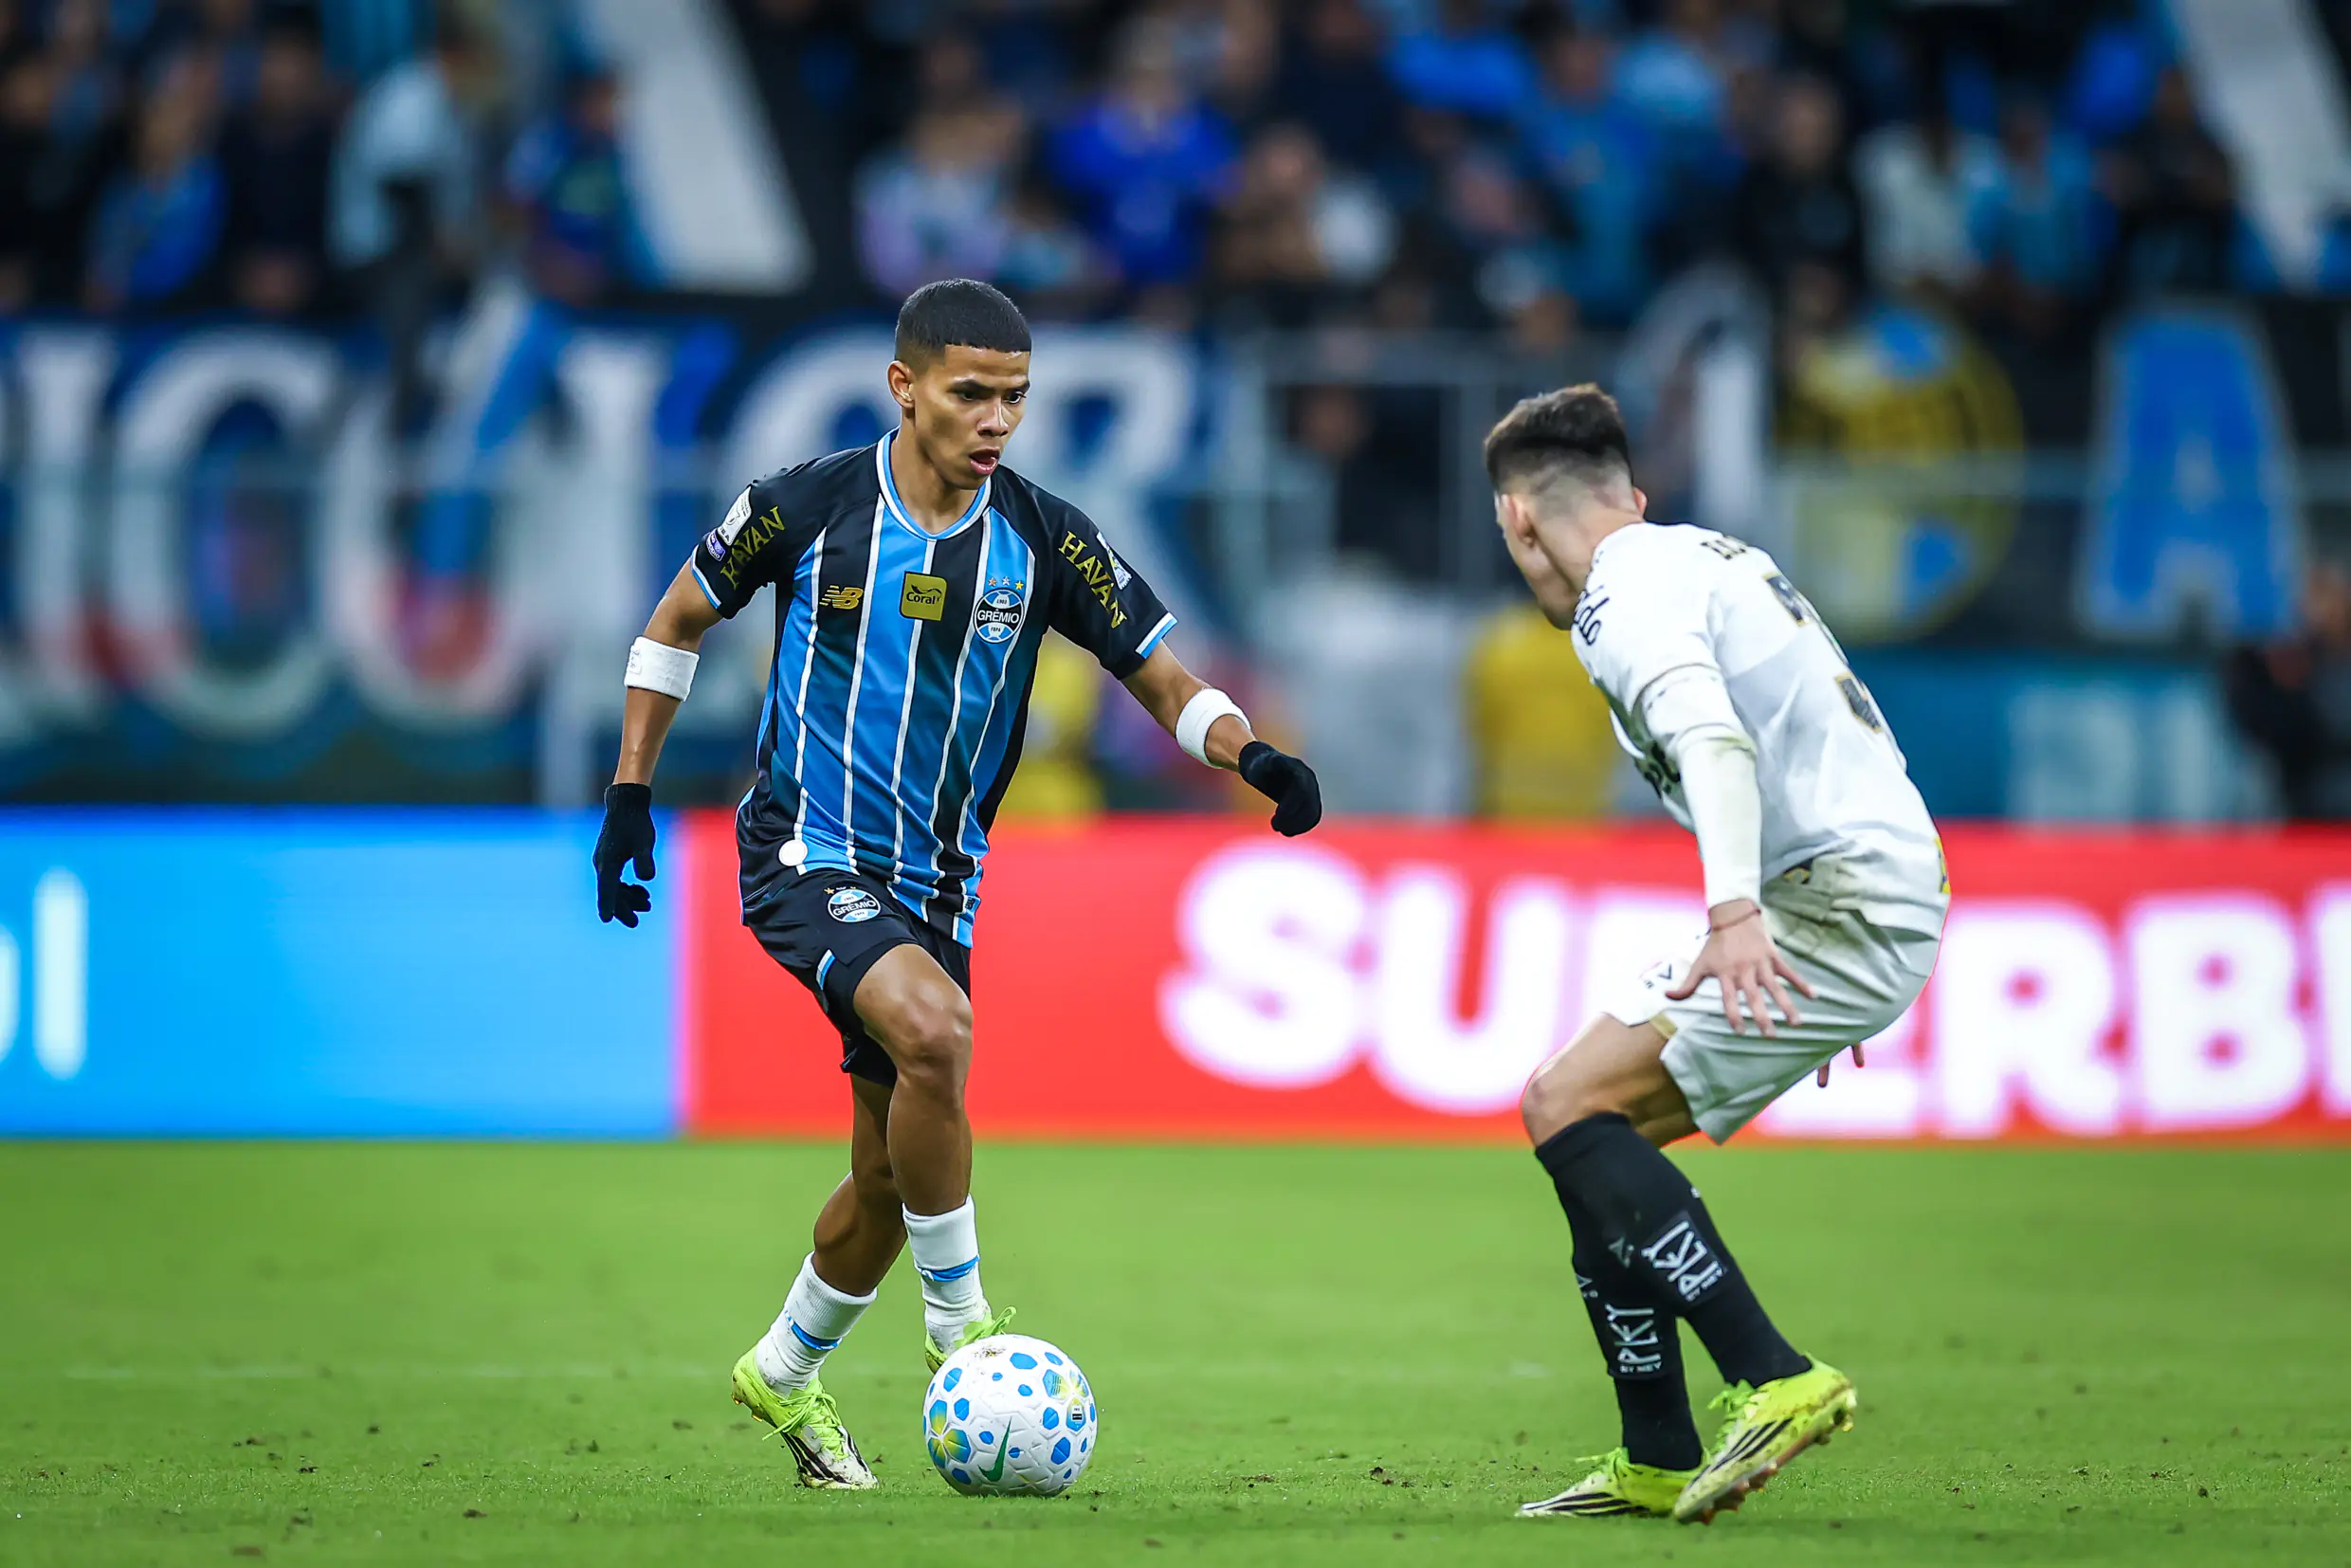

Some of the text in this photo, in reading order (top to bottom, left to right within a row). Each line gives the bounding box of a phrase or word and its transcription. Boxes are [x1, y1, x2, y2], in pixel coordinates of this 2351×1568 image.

[1058, 531, 1127, 628] HAVAN
[906, 591, 936, 605] Coral
[976, 608, 1020, 624] GRÊMIO
